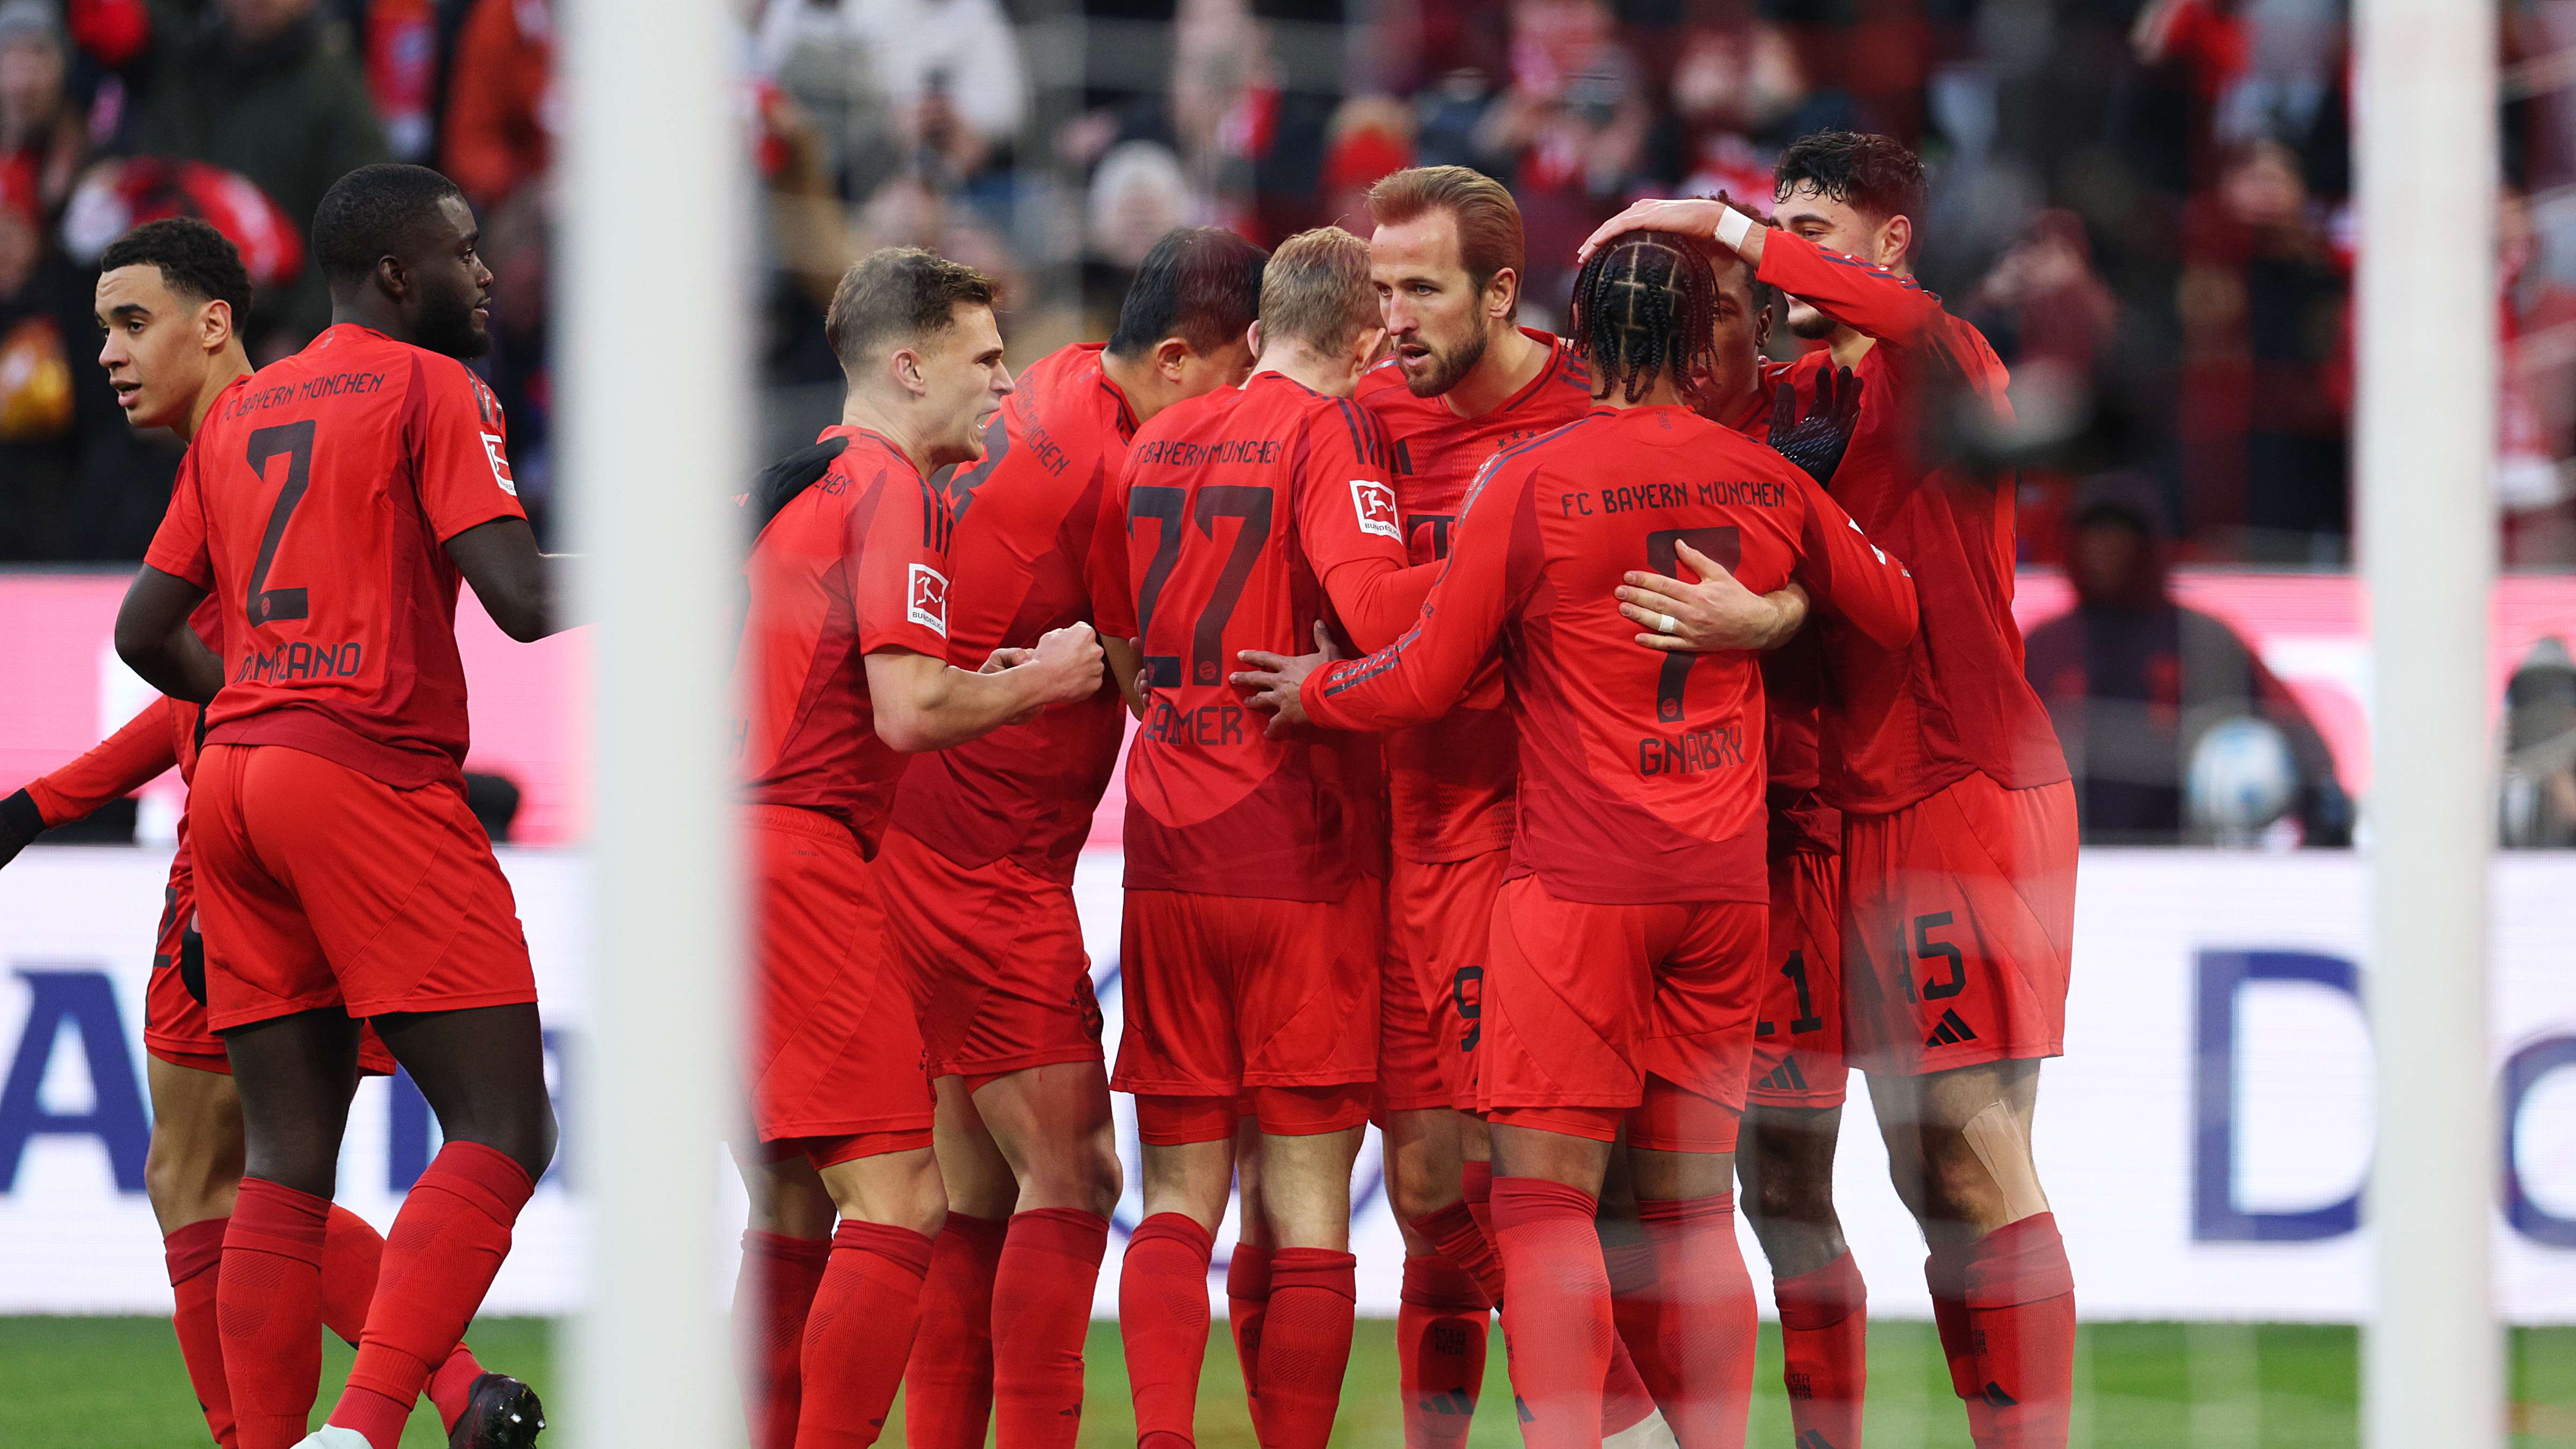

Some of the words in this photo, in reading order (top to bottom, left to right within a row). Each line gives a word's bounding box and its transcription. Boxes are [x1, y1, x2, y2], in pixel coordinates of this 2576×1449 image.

[236, 383, 296, 417] BAYERN
[298, 373, 386, 401] MÜNCHEN
[1143, 440, 1209, 466] BAYERN
[1208, 439, 1284, 464] MÜNCHEN
[1562, 492, 1593, 517] FC
[1601, 482, 1689, 514] BAYERN
[1698, 480, 1785, 508] MÜNCHEN
[246, 419, 317, 628] 2
[1639, 725, 1745, 776] GNABRY
[1453, 965, 1484, 1052] 9
